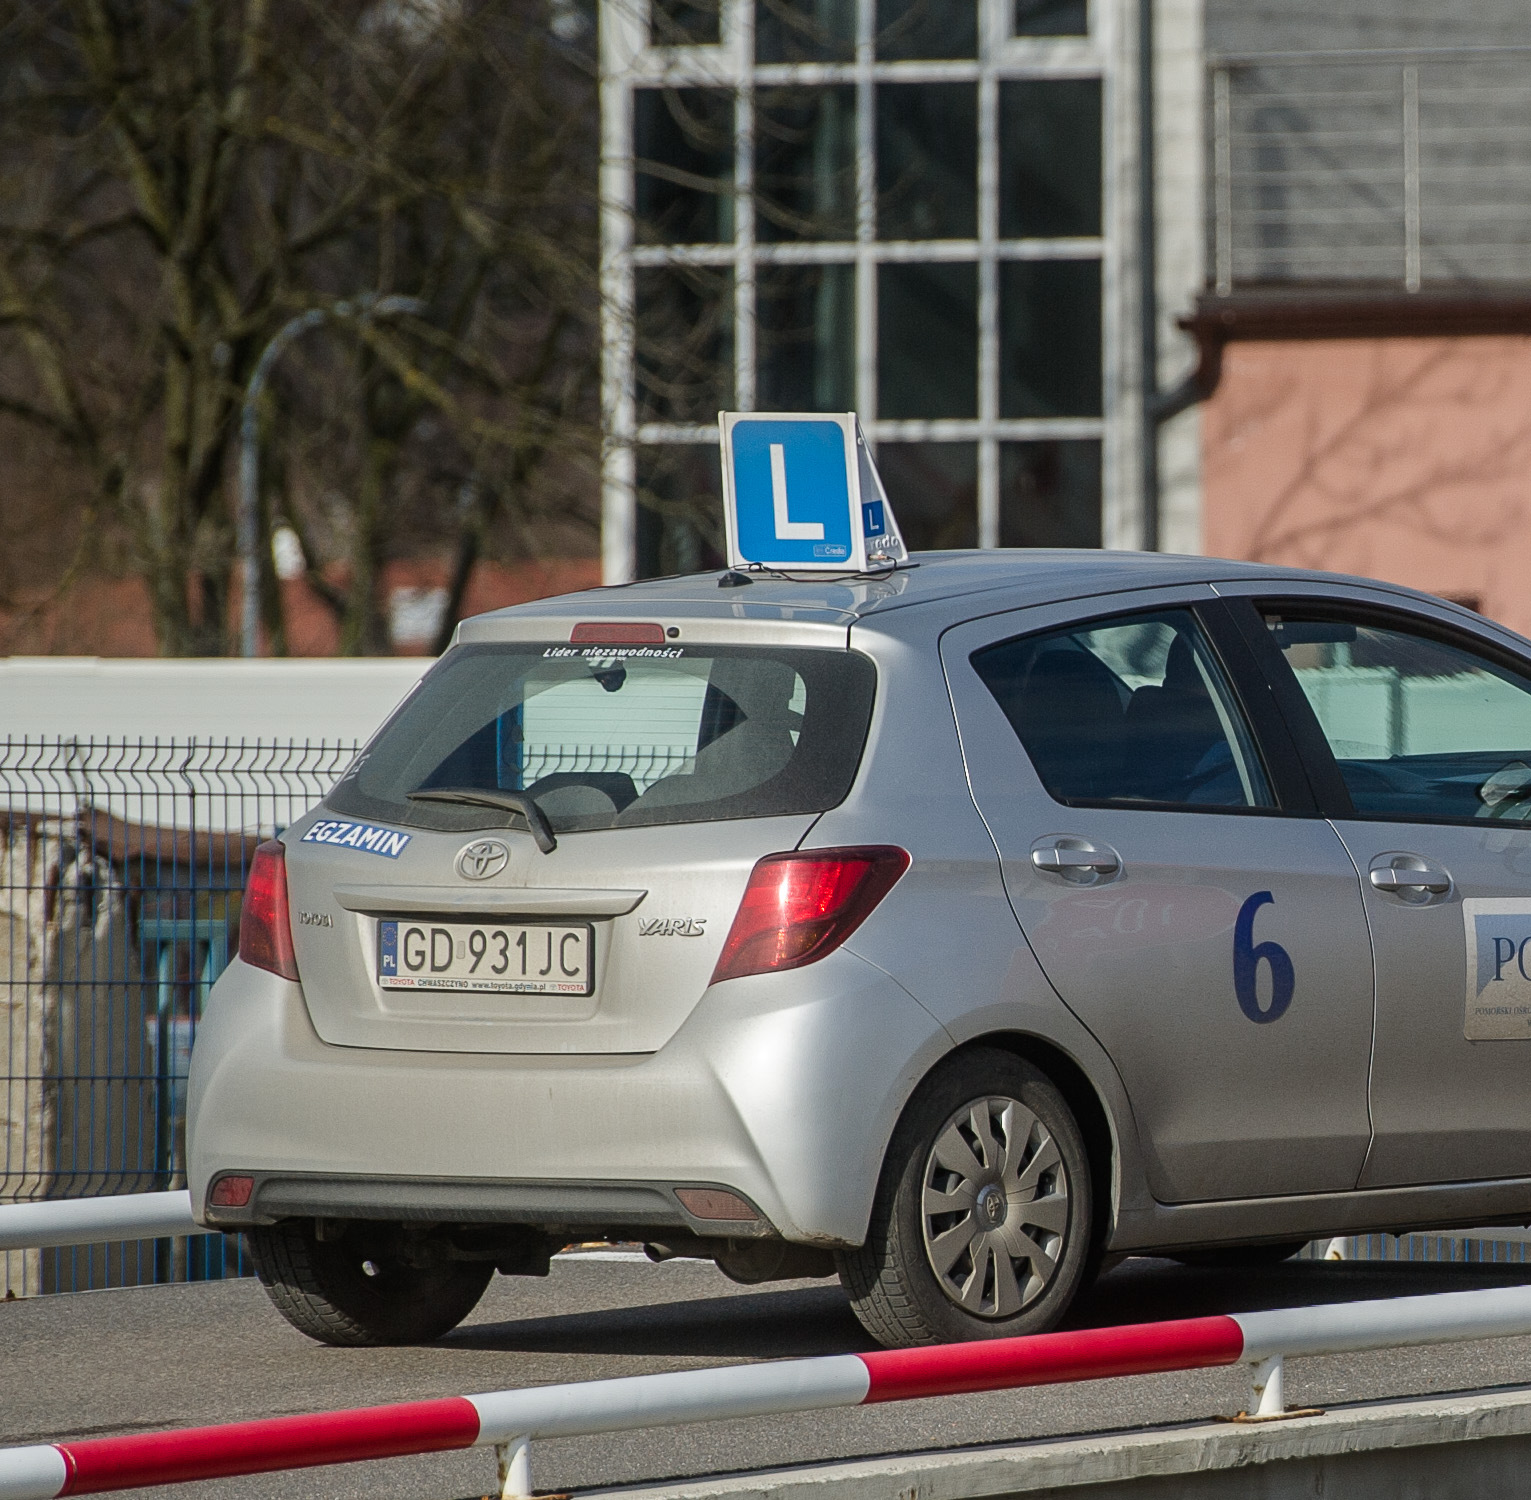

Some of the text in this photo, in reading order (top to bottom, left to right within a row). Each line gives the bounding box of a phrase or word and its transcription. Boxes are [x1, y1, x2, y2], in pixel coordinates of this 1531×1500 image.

[769, 443, 825, 540] L
[868, 509, 880, 531] L
[543, 647, 684, 658] Lider niezawodności
[303, 822, 409, 856] EGZAMIN
[638, 917, 707, 937] YARIS
[383, 955, 396, 967] PL
[403, 927, 580, 977] GD 931JC
[1233, 891, 1295, 1024] 6
[389, 978, 415, 986] TOYOTA
[417, 979, 468, 988] CHWASZCZYNO
